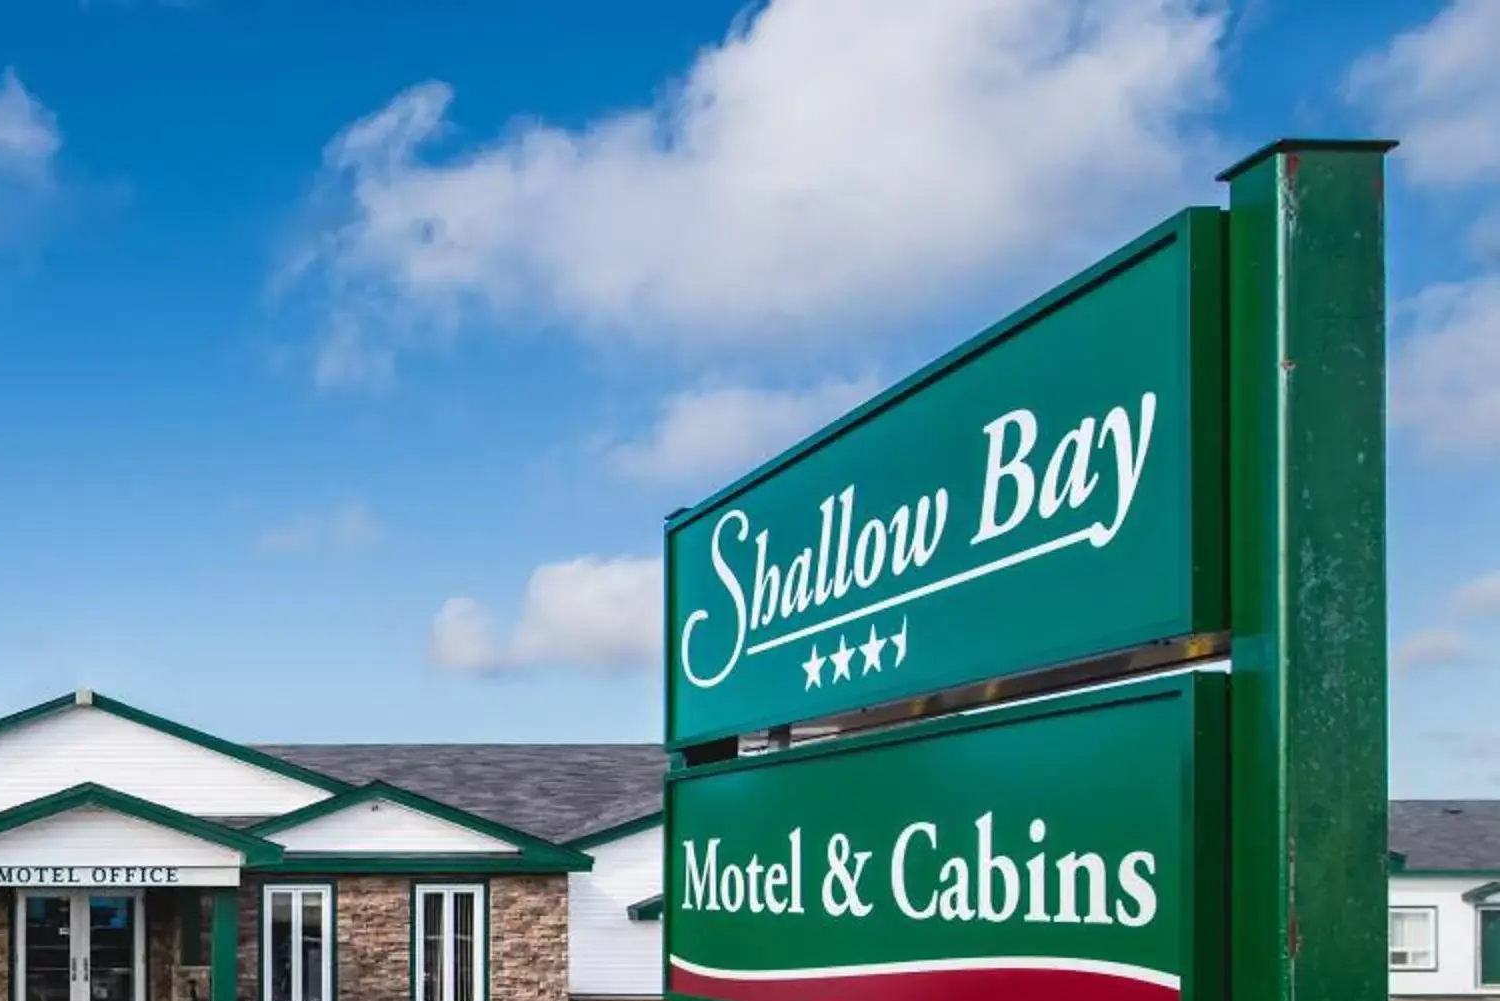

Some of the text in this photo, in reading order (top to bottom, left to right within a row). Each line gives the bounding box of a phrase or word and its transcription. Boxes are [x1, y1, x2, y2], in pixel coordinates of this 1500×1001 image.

[681, 391, 1157, 688] Shallow Bay
[91, 866, 179, 883] OFFICE
[681, 811, 1157, 927] Motel & Cabins
